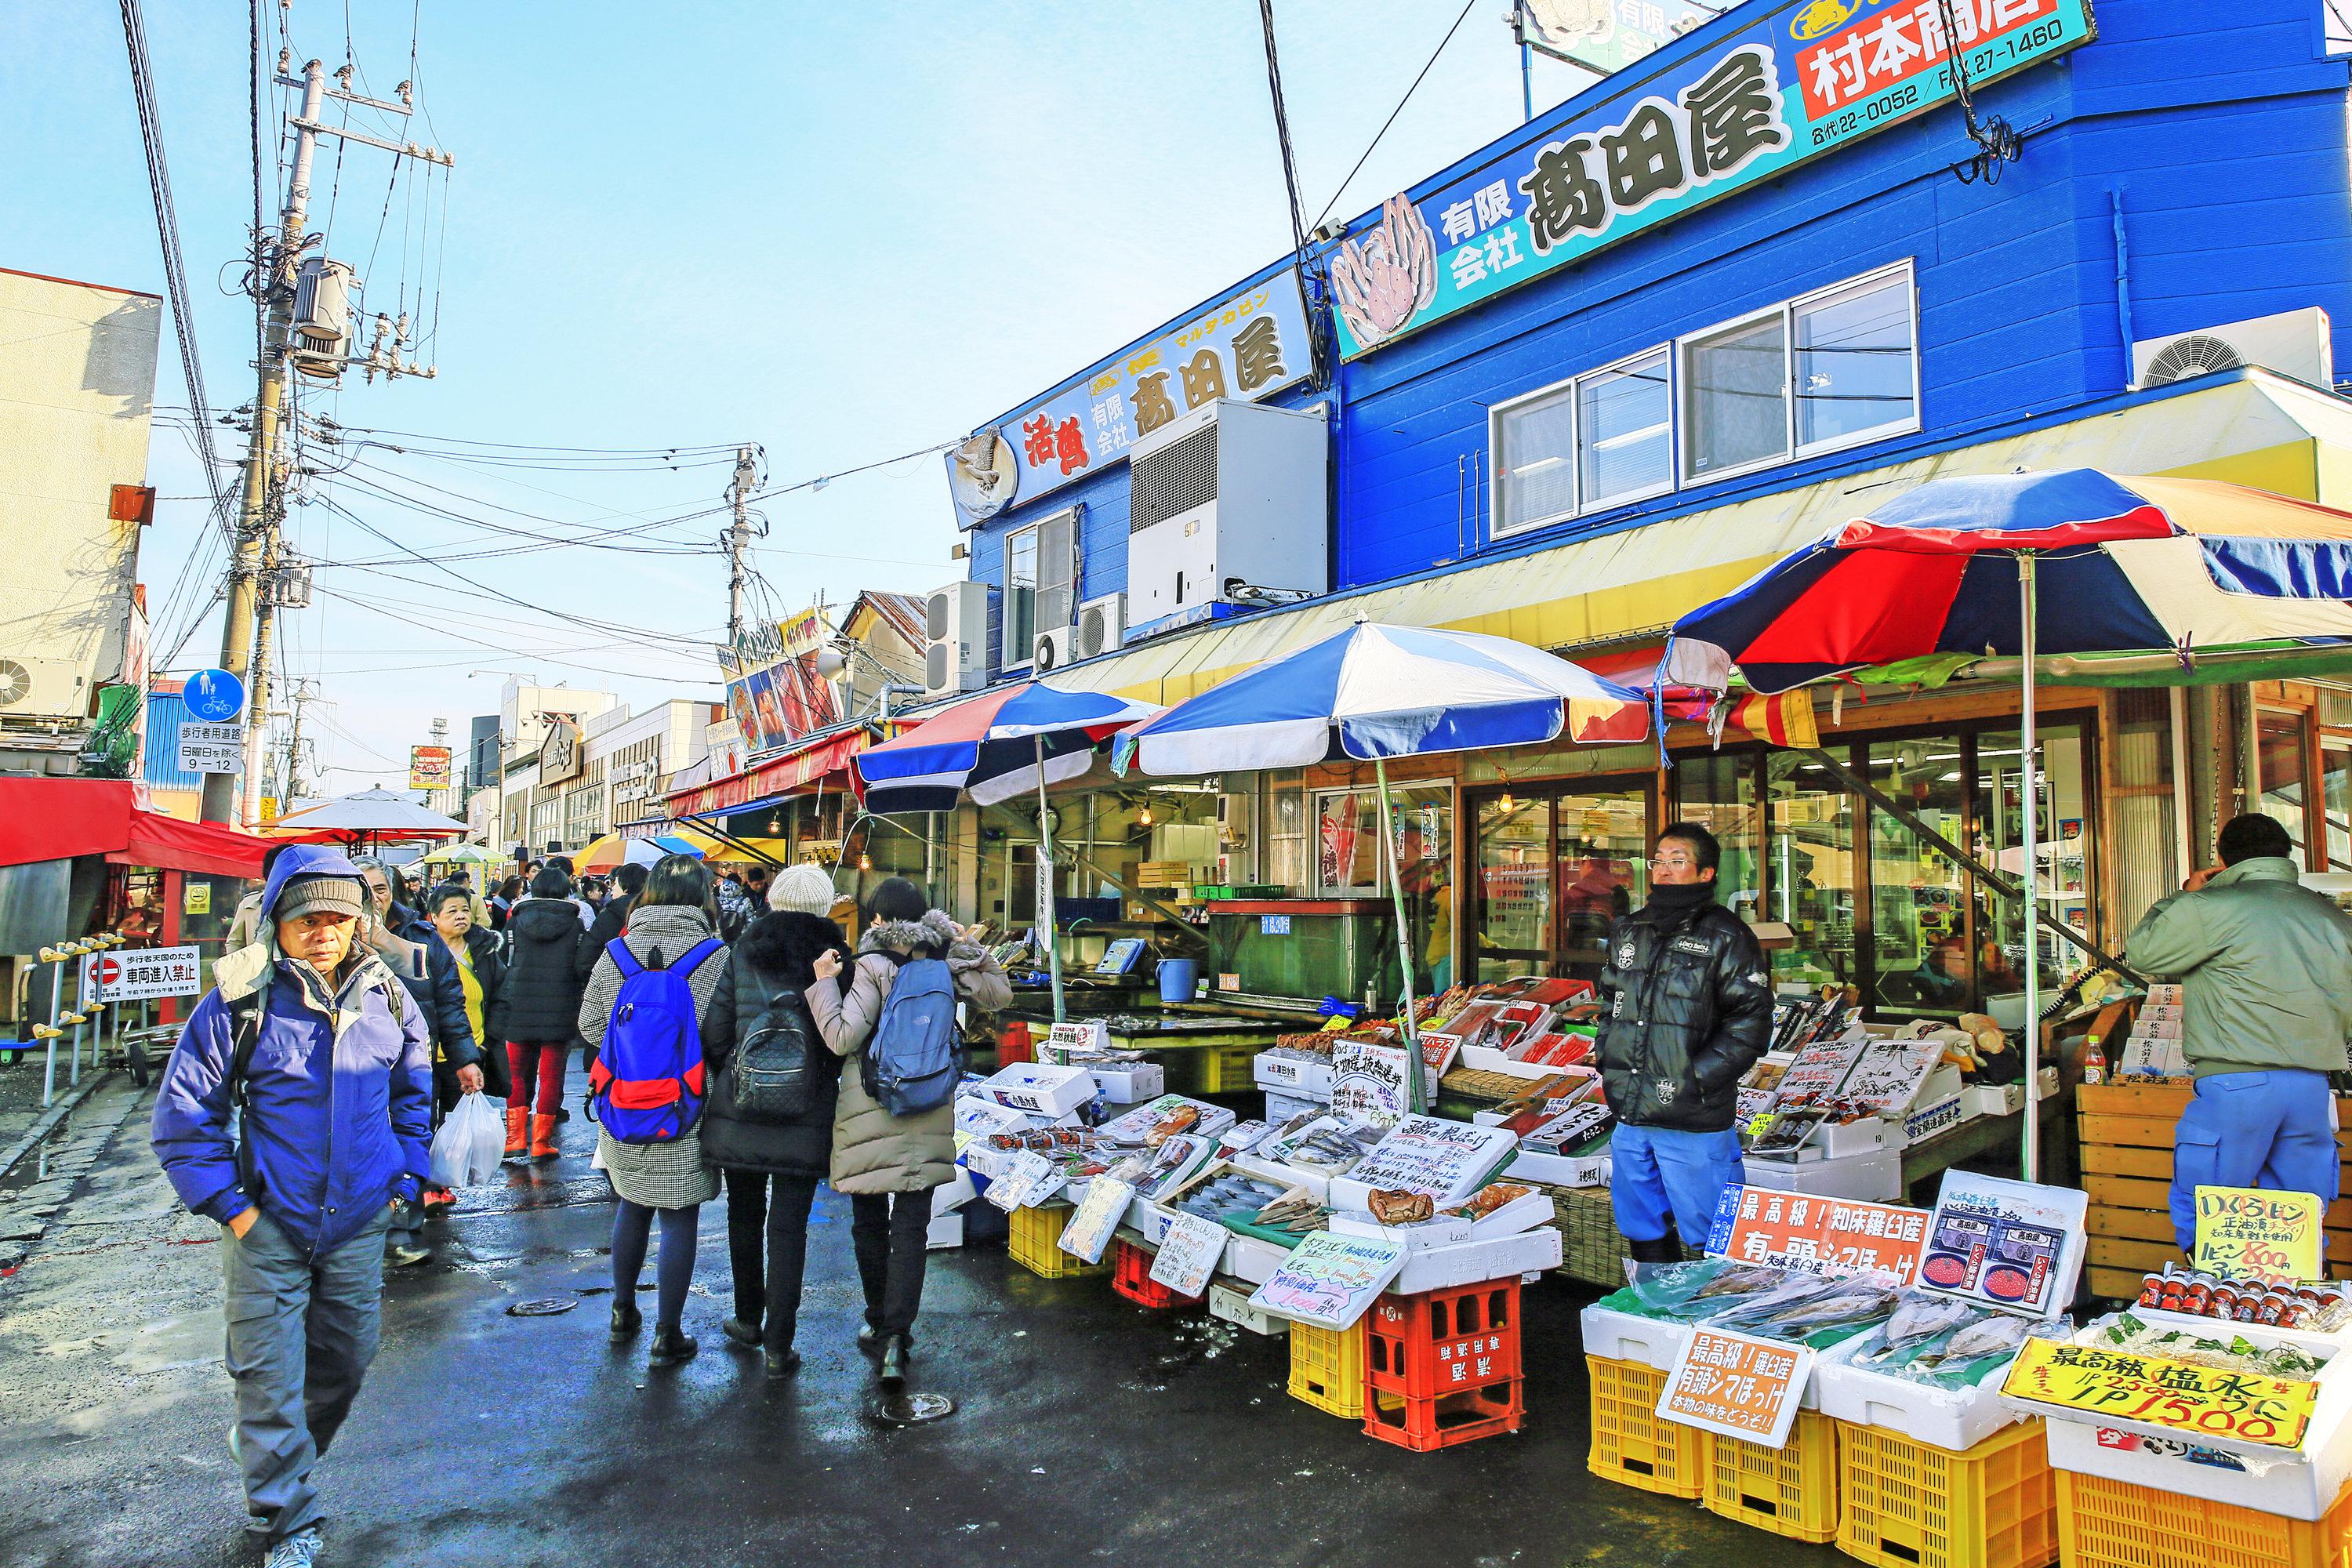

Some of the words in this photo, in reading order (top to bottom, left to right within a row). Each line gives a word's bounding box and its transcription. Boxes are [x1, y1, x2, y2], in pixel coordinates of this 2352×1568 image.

[1618, 0, 1666, 37] 有限
[1809, 0, 2041, 107] 村本商店
[1439, 178, 1514, 246] 有限
[1450, 227, 1524, 292] 会社
[1091, 393, 1124, 430] 有限
[1097, 423, 1130, 457] 会社
[182, 727, 241, 740] 歩行者用道路
[182, 746, 239, 759] 日曜日を除く
[126, 953, 194, 964] 歩行者天国のため
[126, 964, 195, 985] 車両進入禁止
[126, 985, 196, 995] 午前7時から午後1時まで
[1052, 1032, 1076, 1043] 天然秋鮭
[1583, 1126, 1600, 1142] たらこ
[1915, 1110, 1953, 1137] 室蘭追直港
[2201, 1196, 2304, 1221] いくらビン
[1830, 1205, 1924, 1243] 知床羅臼産
[2221, 1217, 2267, 1231] 正油漬
[2241, 1241, 2288, 1268] 800
[1274, 1276, 1318, 1293] 特別価格
[1451, 1356, 1491, 1382] 清酒
[1752, 1351, 1795, 1381] 羅臼産
[2046, 1348, 2148, 1381] 最高級
[2154, 1366, 2264, 1398] 塩水
[1678, 1363, 1786, 1413] 有頭シマほっけ
[1672, 1394, 1774, 1432] 本物の味をどうぞ!!
[2127, 1395, 2277, 1439] 1500
